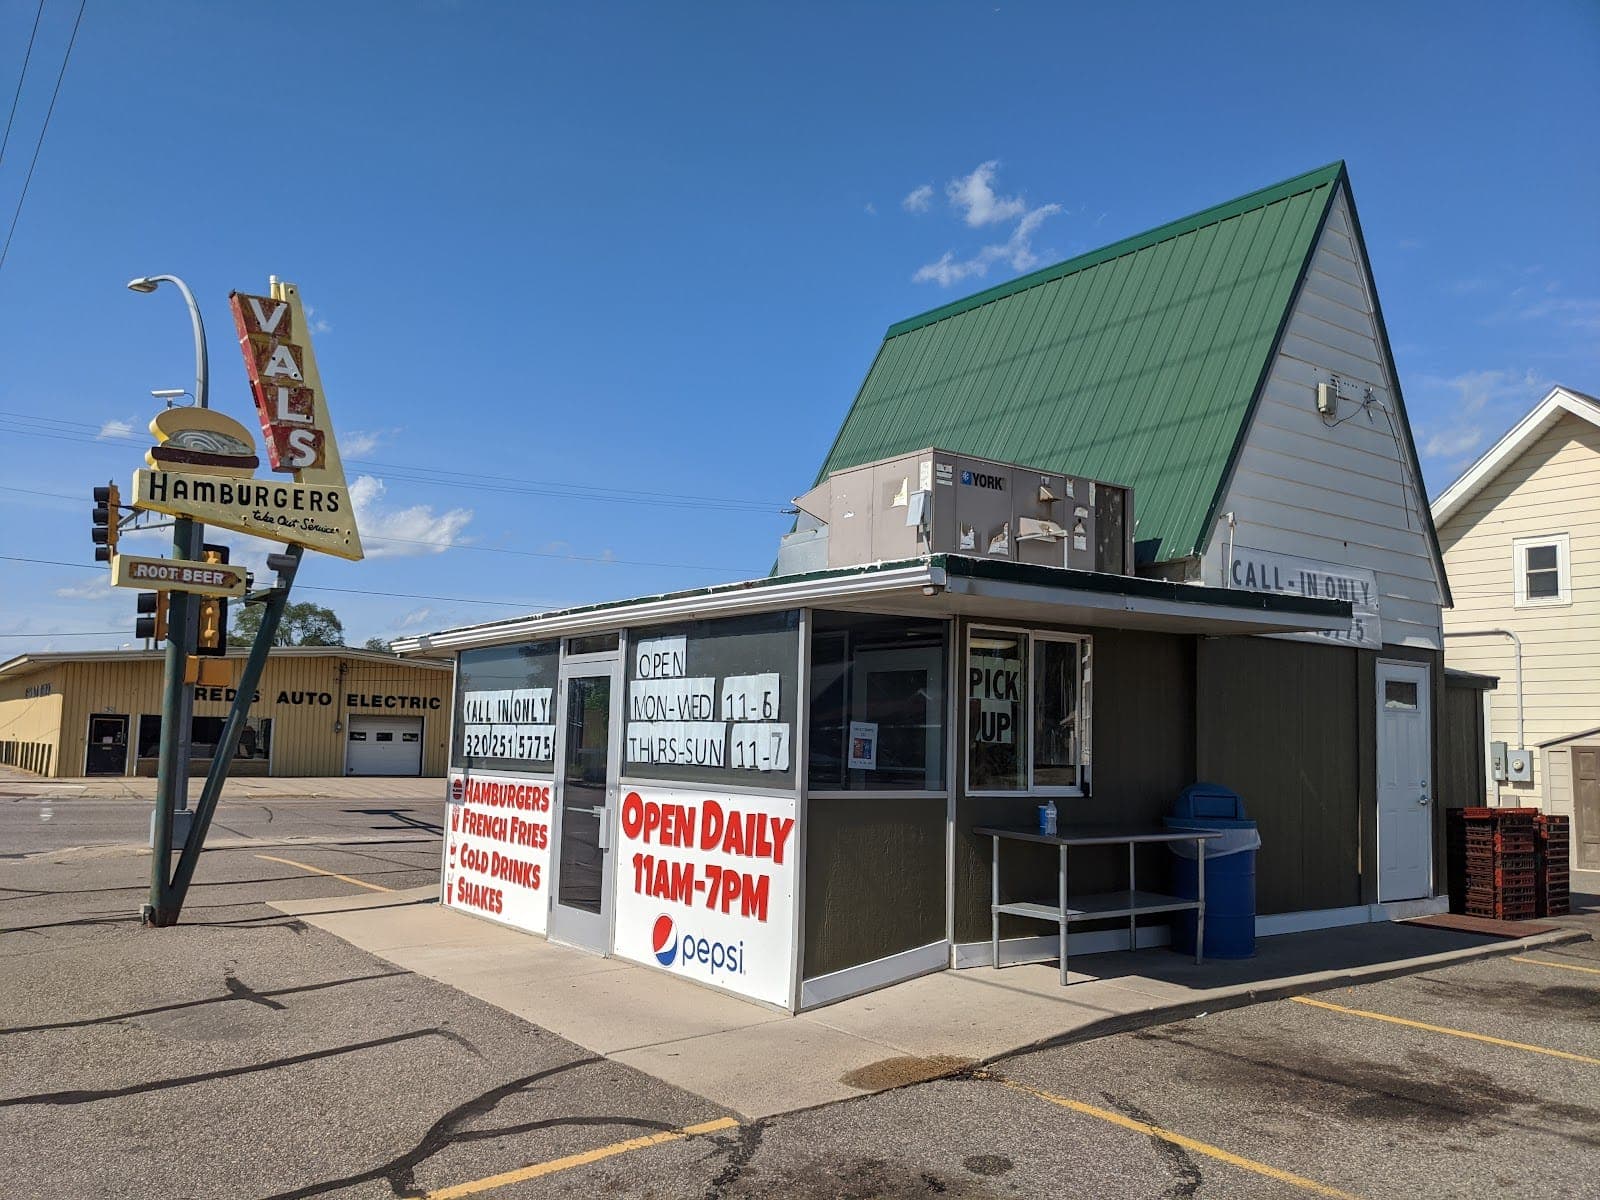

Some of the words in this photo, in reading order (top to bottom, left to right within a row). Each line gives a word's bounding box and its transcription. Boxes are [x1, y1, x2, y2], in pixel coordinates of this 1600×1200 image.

[248, 298, 318, 468] VALS
[972, 472, 1004, 491] YORK
[277, 515, 300, 527] Out
[137, 564, 179, 579] ROOT
[182, 568, 225, 585] BEER
[1325, 575, 1370, 606] ONLY
[639, 650, 684, 678] OPEN
[969, 667, 1019, 700] PICK
[276, 691, 332, 706] AUTO
[346, 693, 441, 711] ELECTRIC
[498, 699, 509, 722] IN
[514, 697, 549, 722] ONLY
[634, 693, 712, 720] MON-WED
[981, 711, 1011, 742] UP
[466, 733, 488, 756] 320
[493, 734, 513, 758] 251
[518, 735, 551, 759] 5775
[736, 731, 784, 768] 11-7
[464, 778, 550, 813] HAMBURGERS
[462, 808, 508, 843] FRENCH
[509, 816, 548, 850] FRIES
[621, 791, 697, 849] OPEN
[700, 800, 795, 865] DAILY
[460, 843, 489, 874] COLD
[491, 851, 541, 890] DRINKS
[457, 876, 503, 914] SHAKES
[632, 852, 771, 923] 11AM-7PM
[682, 934, 745, 975] pepsi
